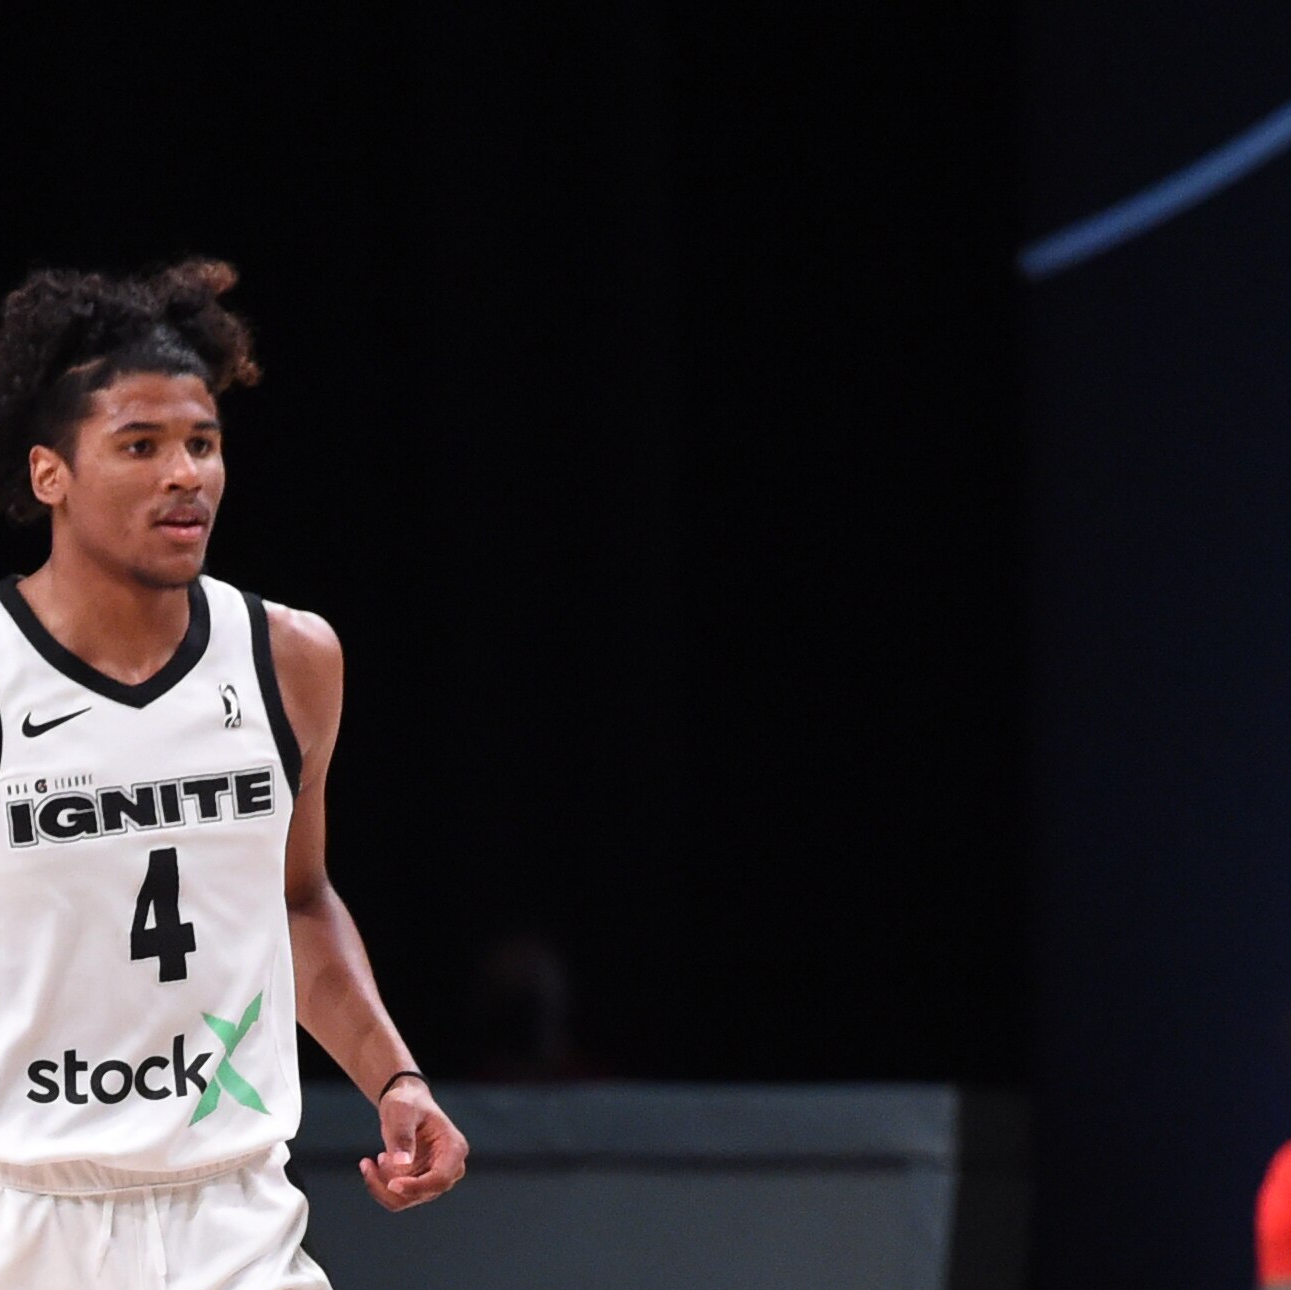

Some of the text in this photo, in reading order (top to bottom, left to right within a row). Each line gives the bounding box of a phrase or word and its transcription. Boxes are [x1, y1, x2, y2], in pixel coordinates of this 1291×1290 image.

[7, 766, 275, 848] IGNITE
[130, 847, 196, 982] 4
[26, 990, 272, 1128] stockX
